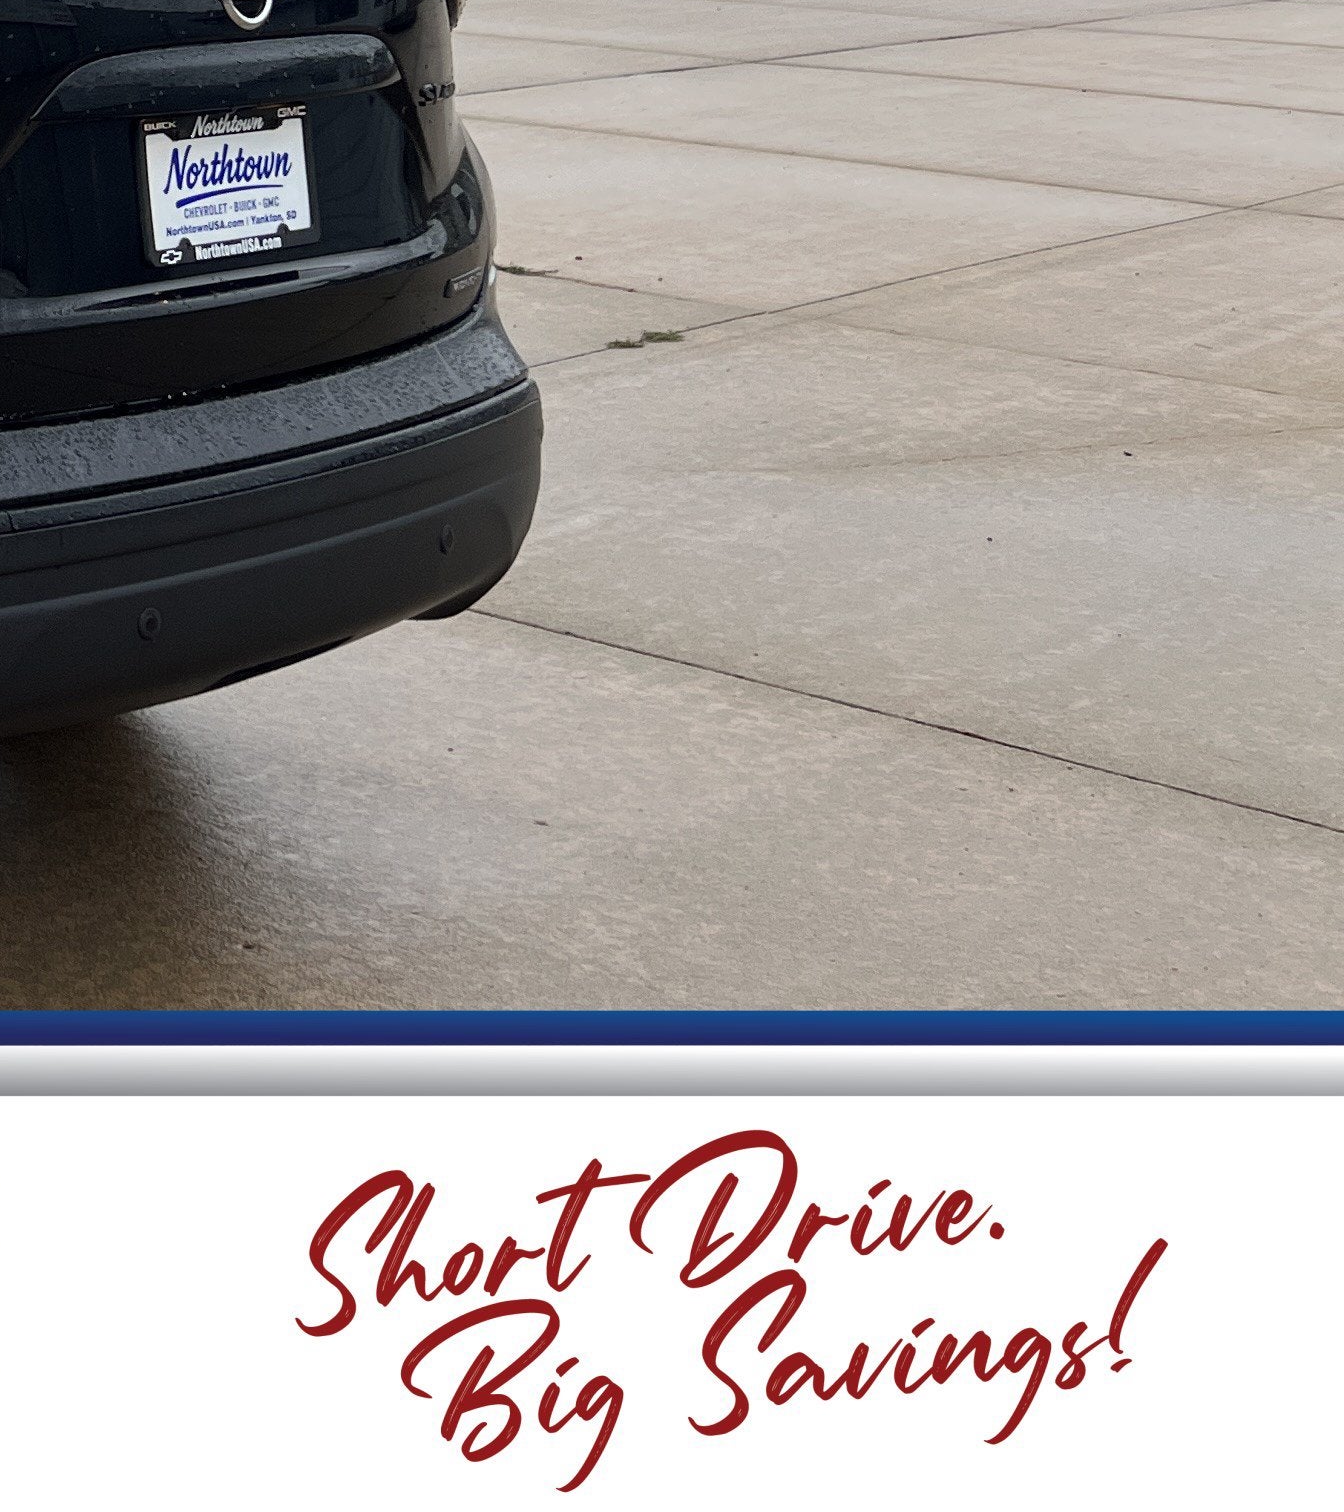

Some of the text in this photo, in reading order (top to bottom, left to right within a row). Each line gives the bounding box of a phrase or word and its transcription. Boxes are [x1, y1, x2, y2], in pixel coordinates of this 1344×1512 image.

[144, 105, 307, 138] BUICK Northtown GMC
[163, 143, 293, 194] Northtown
[184, 196, 280, 219] CHEVROLET BUICK GMC
[166, 218, 245, 237] NorthtownUSA.com
[286, 210, 297, 220] SD
[195, 236, 282, 260] NorthtownUSA.com
